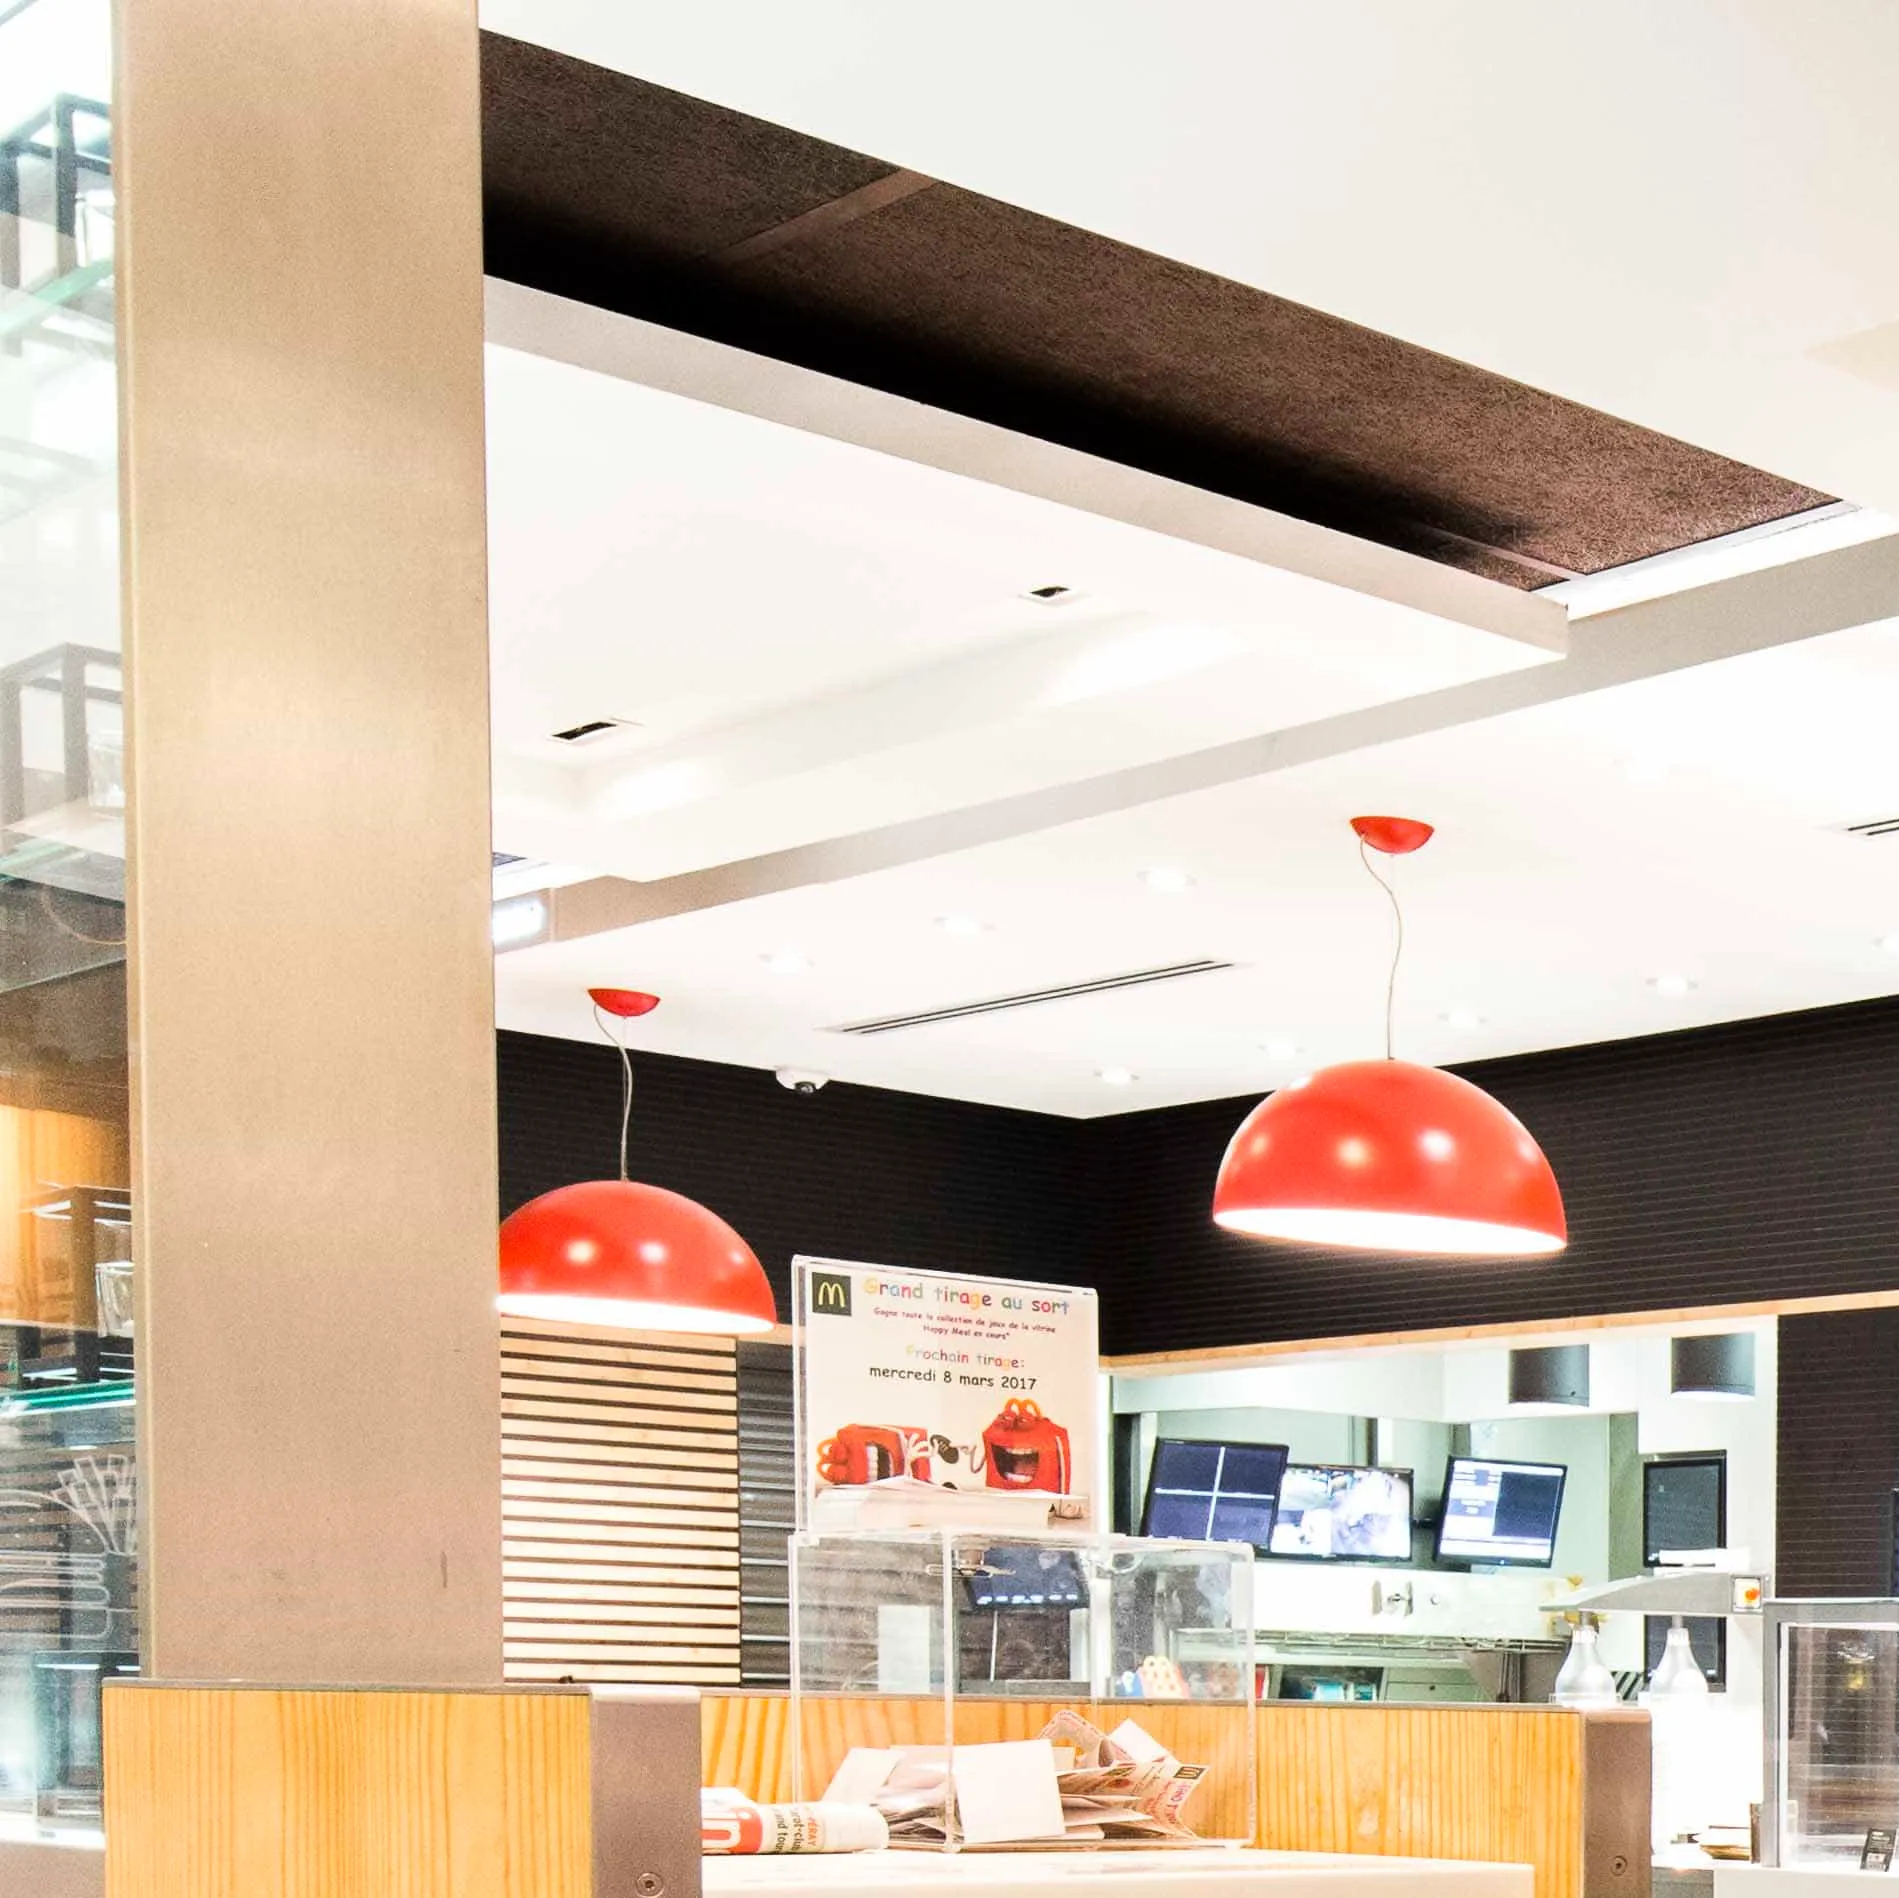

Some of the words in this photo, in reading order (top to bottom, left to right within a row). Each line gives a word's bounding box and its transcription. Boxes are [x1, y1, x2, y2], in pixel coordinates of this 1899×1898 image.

[863, 1277, 923, 1299] Grand
[934, 1286, 992, 1311] tirage
[1001, 1296, 1023, 1310] au
[1031, 1299, 1069, 1315] sort
[873, 1306, 898, 1317] Gagne
[936, 1314, 973, 1324] collection
[975, 1318, 985, 1326] de
[1022, 1322, 1029, 1330] la
[1032, 1324, 1056, 1333] vitrine
[923, 1325, 949, 1335] Happy
[952, 1327, 971, 1336] Meal
[905, 1344, 969, 1364] Prochain
[976, 1353, 1025, 1371] tirage:
[869, 1365, 936, 1382] mercredi
[943, 1370, 953, 1384] 8
[959, 1375, 995, 1388] mars
[1001, 1375, 1038, 1391] 2017
